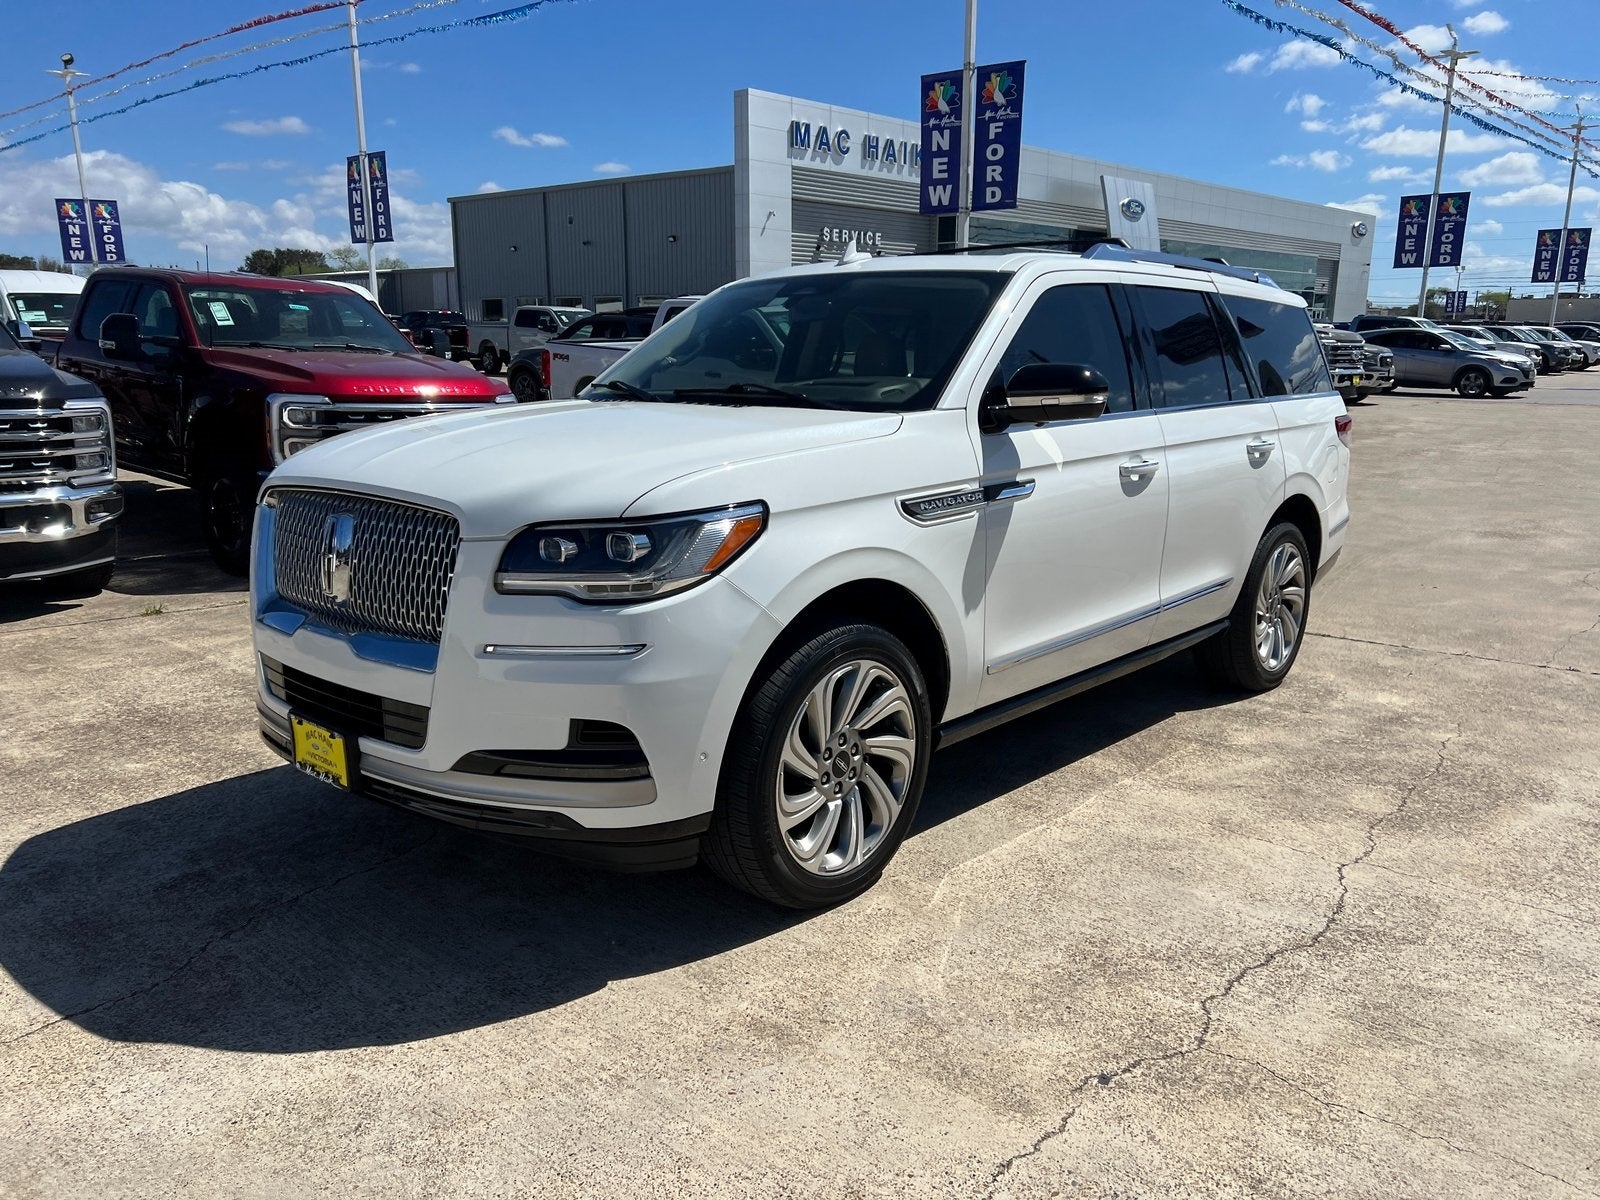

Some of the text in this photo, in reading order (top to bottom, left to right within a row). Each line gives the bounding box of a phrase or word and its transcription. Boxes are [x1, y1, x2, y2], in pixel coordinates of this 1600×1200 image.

[792, 120, 851, 157] MAC
[928, 129, 952, 206] NEW
[985, 121, 1004, 204] FORD
[352, 190, 365, 238] NEW
[376, 188, 386, 239] FORD
[68, 224, 84, 261] NEW
[103, 225, 117, 261] FORD
[823, 226, 882, 245] SERVICE
[1401, 224, 1418, 264] NEW
[1439, 222, 1455, 264] FORD
[1537, 250, 1552, 280] NEW
[1567, 249, 1580, 280] FORD
[920, 492, 984, 511] NAVIGATOR
